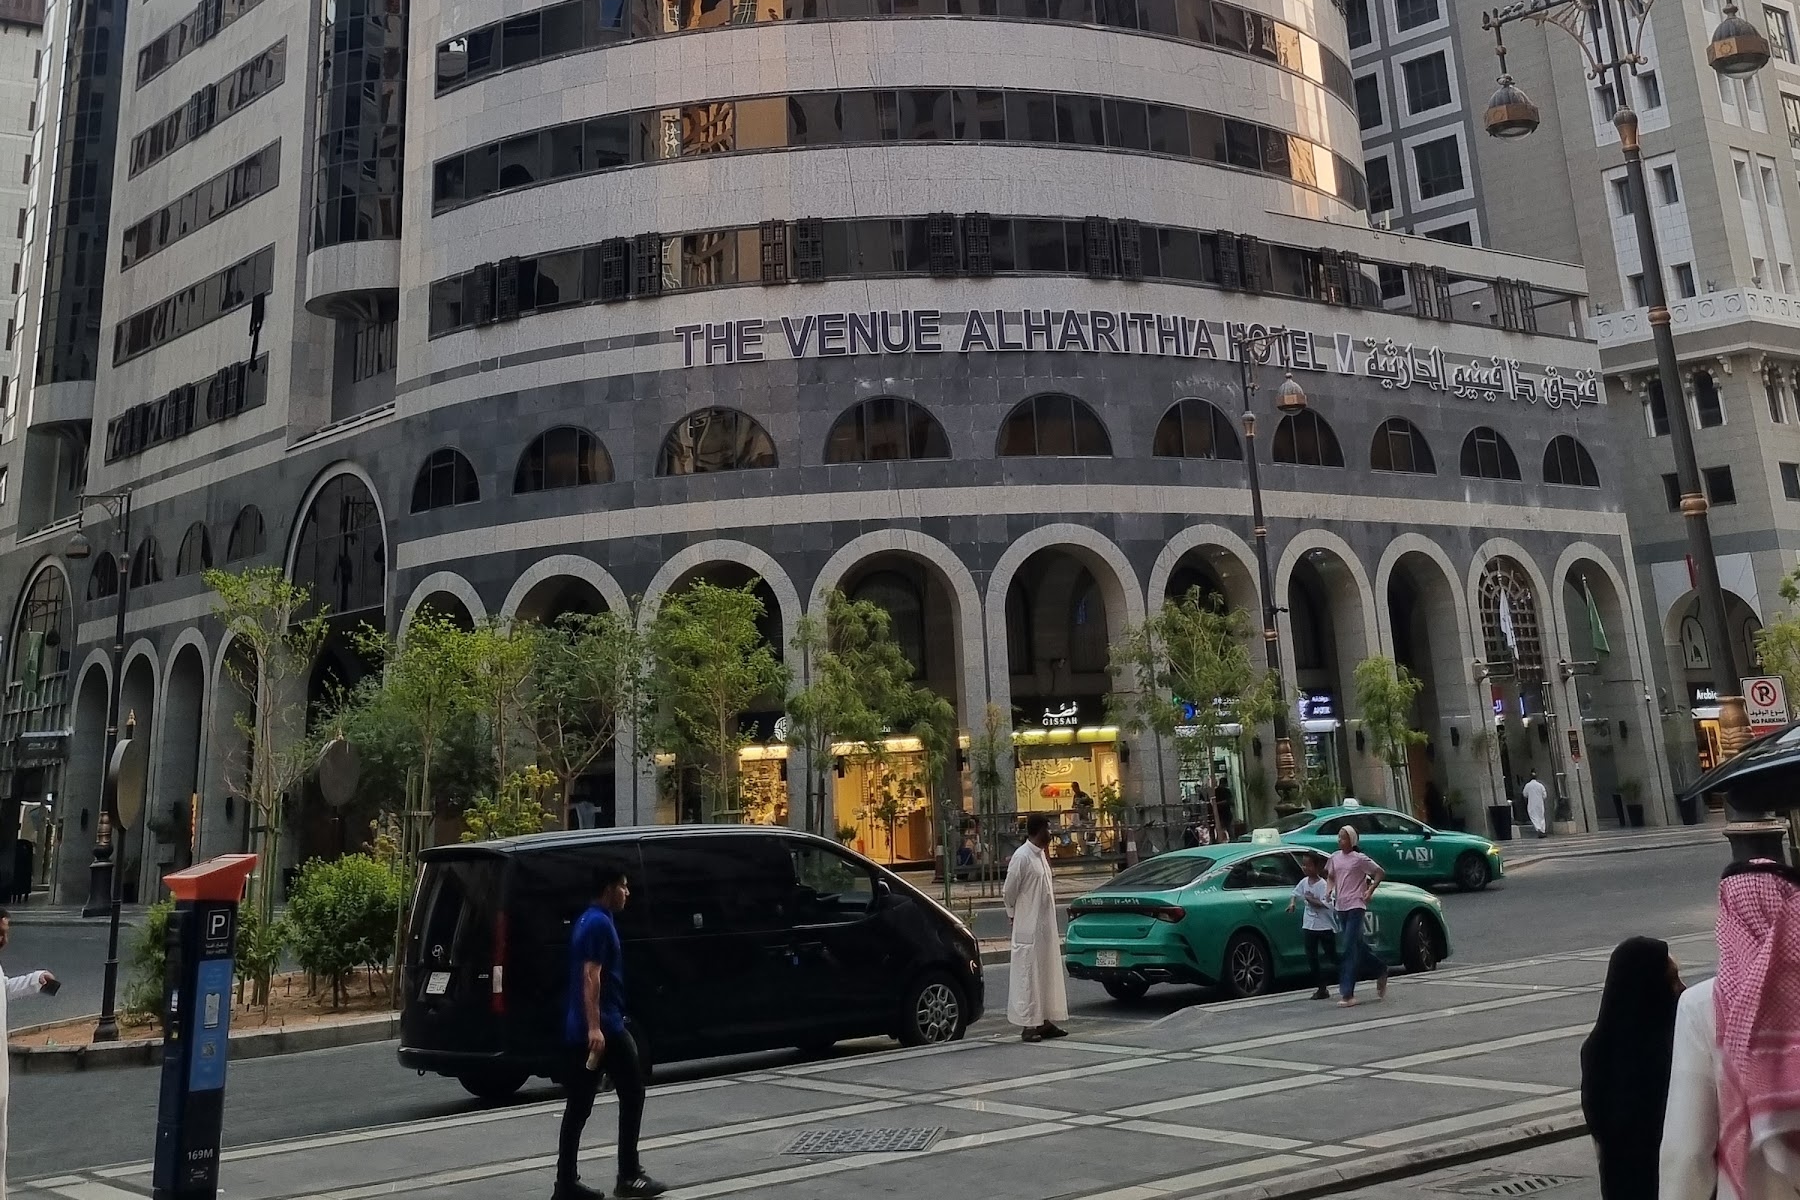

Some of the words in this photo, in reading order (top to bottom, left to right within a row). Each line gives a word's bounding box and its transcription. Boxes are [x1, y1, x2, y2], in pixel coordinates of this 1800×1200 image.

[674, 318, 765, 368] THE
[780, 308, 942, 359] VENUE
[960, 308, 1218, 360] ALHARITHIA
[1224, 321, 1328, 372] HOTEL
[1366, 337, 1448, 391] الحارثية
[1505, 357, 1537, 404] ذا
[1541, 365, 1599, 409] فندق
[1042, 717, 1078, 726] GISSAH
[211, 915, 226, 935] P
[187, 1149, 213, 1160] 169M
